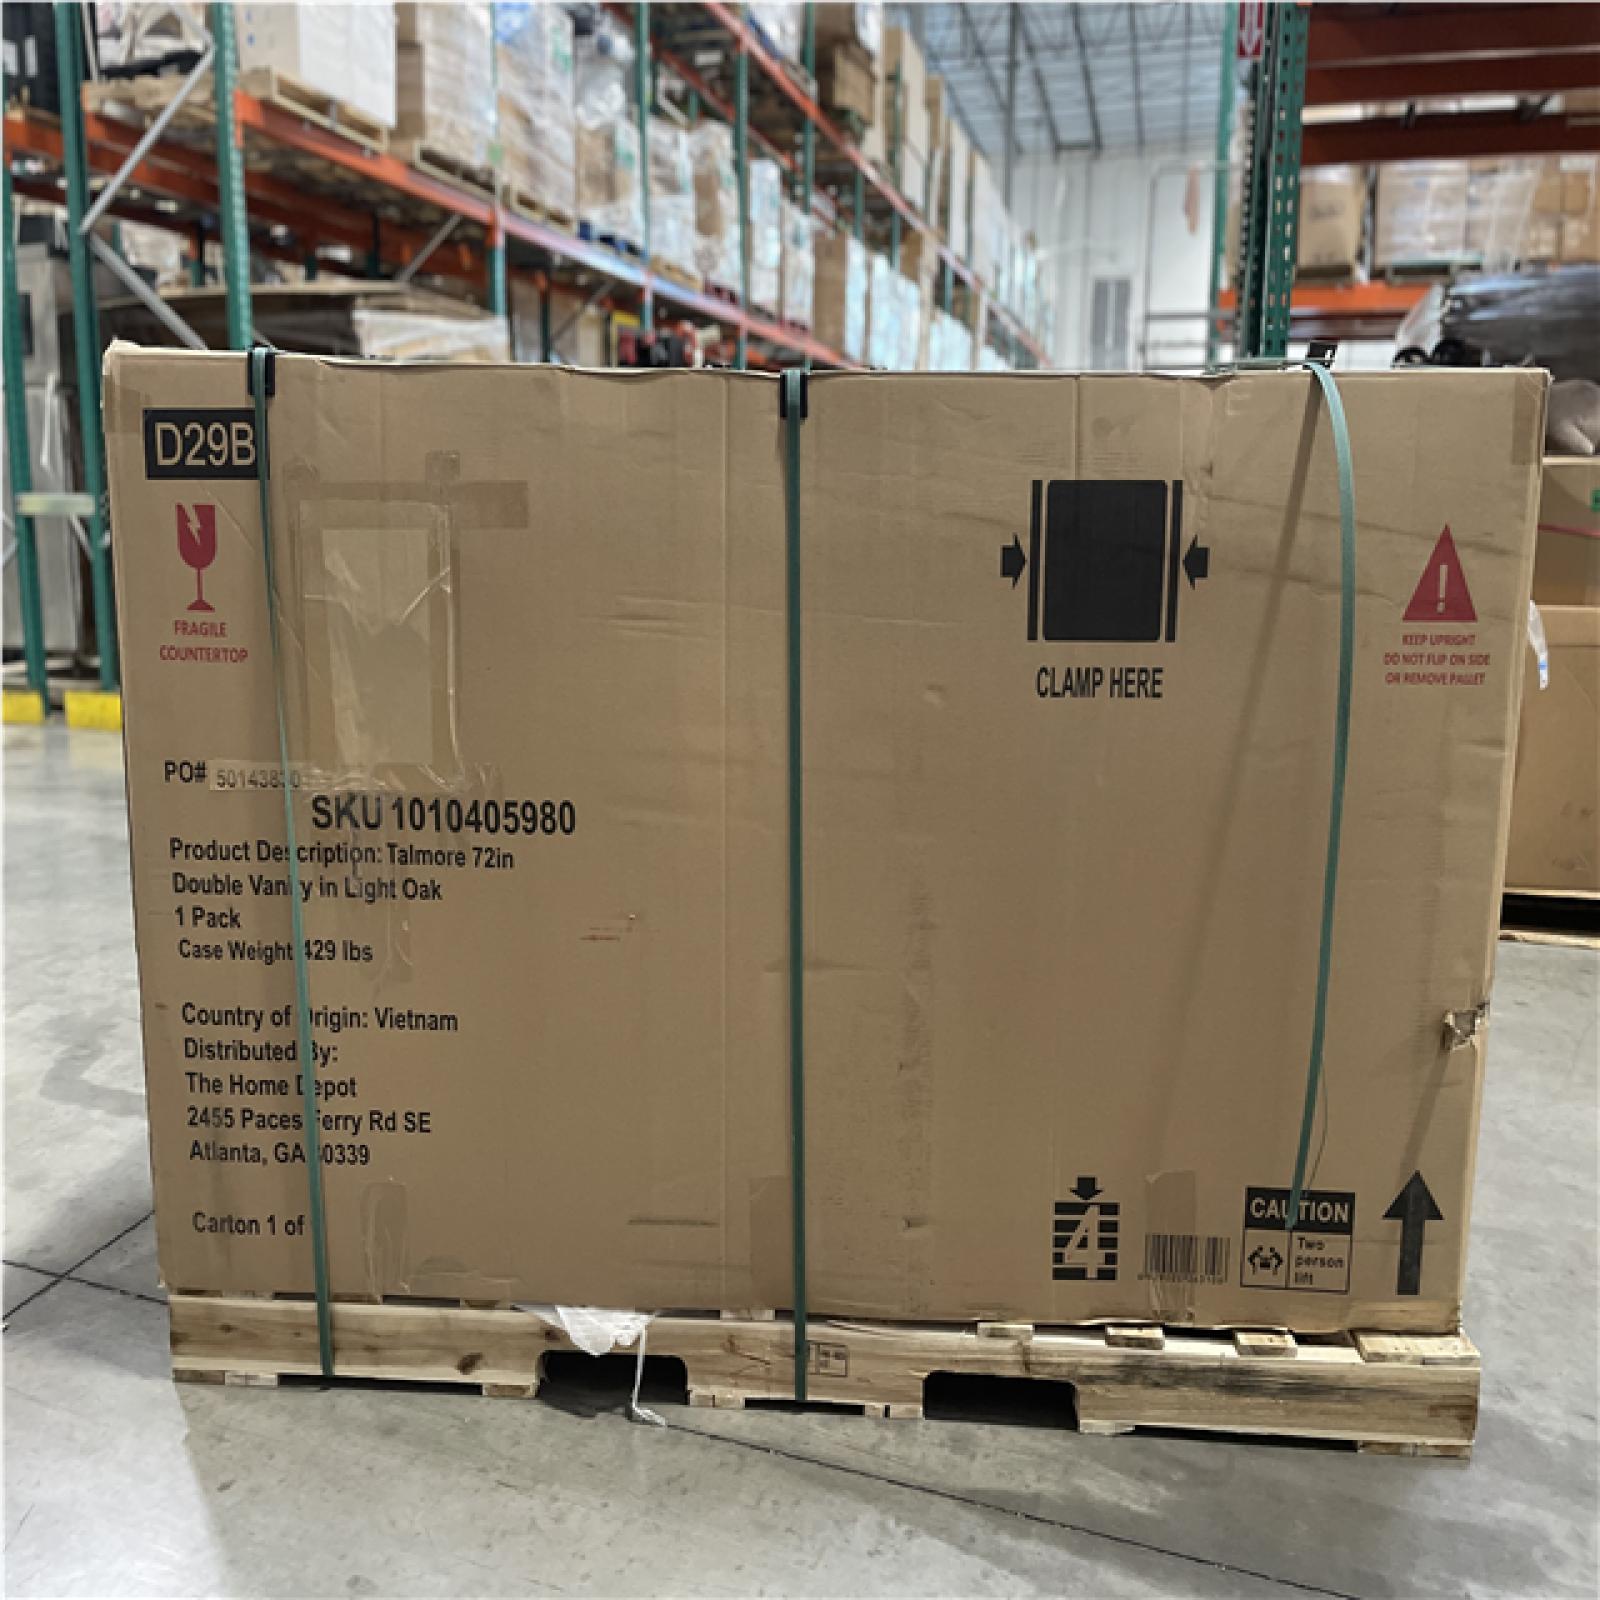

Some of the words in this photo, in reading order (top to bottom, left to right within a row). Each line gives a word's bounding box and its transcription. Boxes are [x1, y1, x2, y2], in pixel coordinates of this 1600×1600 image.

[154, 421, 256, 467] D29B
[174, 619, 228, 638] FRAGILE
[1402, 634, 1427, 646] KEEP
[1430, 634, 1476, 646] UPRIGHT
[159, 645, 249, 663] COUNTERTOP
[1449, 654, 1466, 666] ON
[1036, 667, 1103, 698] CLAMP
[1109, 667, 1163, 698] HERE
[164, 760, 207, 783] PO#
[216, 769, 300, 788] 5014380
[312, 793, 382, 829] SKU
[391, 798, 577, 835] 1010405980
[170, 837, 251, 860] Product
[387, 843, 466, 867] Talmore
[472, 847, 515, 869] 72in
[172, 872, 243, 897] Double
[249, 874, 313, 903] Vaniy
[320, 875, 338, 898] in
[345, 877, 396, 904] Light
[402, 878, 443, 901] Oak
[174, 907, 186, 928] 1
[191, 907, 242, 930] Pack
[178, 939, 223, 961] Case
[343, 939, 374, 962] lbs
[181, 1002, 265, 1032] Country
[270, 1004, 292, 1027] of
[309, 1006, 369, 1033] rigin:
[374, 1007, 459, 1032] Vietnam
[184, 1038, 297, 1061] Distributed
[185, 1072, 223, 1095] The
[229, 1074, 289, 1096] Home
[187, 1106, 235, 1129] 2455
[241, 1108, 303, 1132] Paces
[316, 1109, 363, 1136] erry
[369, 1110, 397, 1132] Rd
[404, 1111, 432, 1134] SE
[189, 1140, 268, 1166] Atlanta,
[274, 1142, 306, 1164] GA
[319, 1144, 370, 1166] 0339
[192, 1213, 261, 1236] Carton
[267, 1215, 277, 1236] 1
[284, 1215, 305, 1237] of
